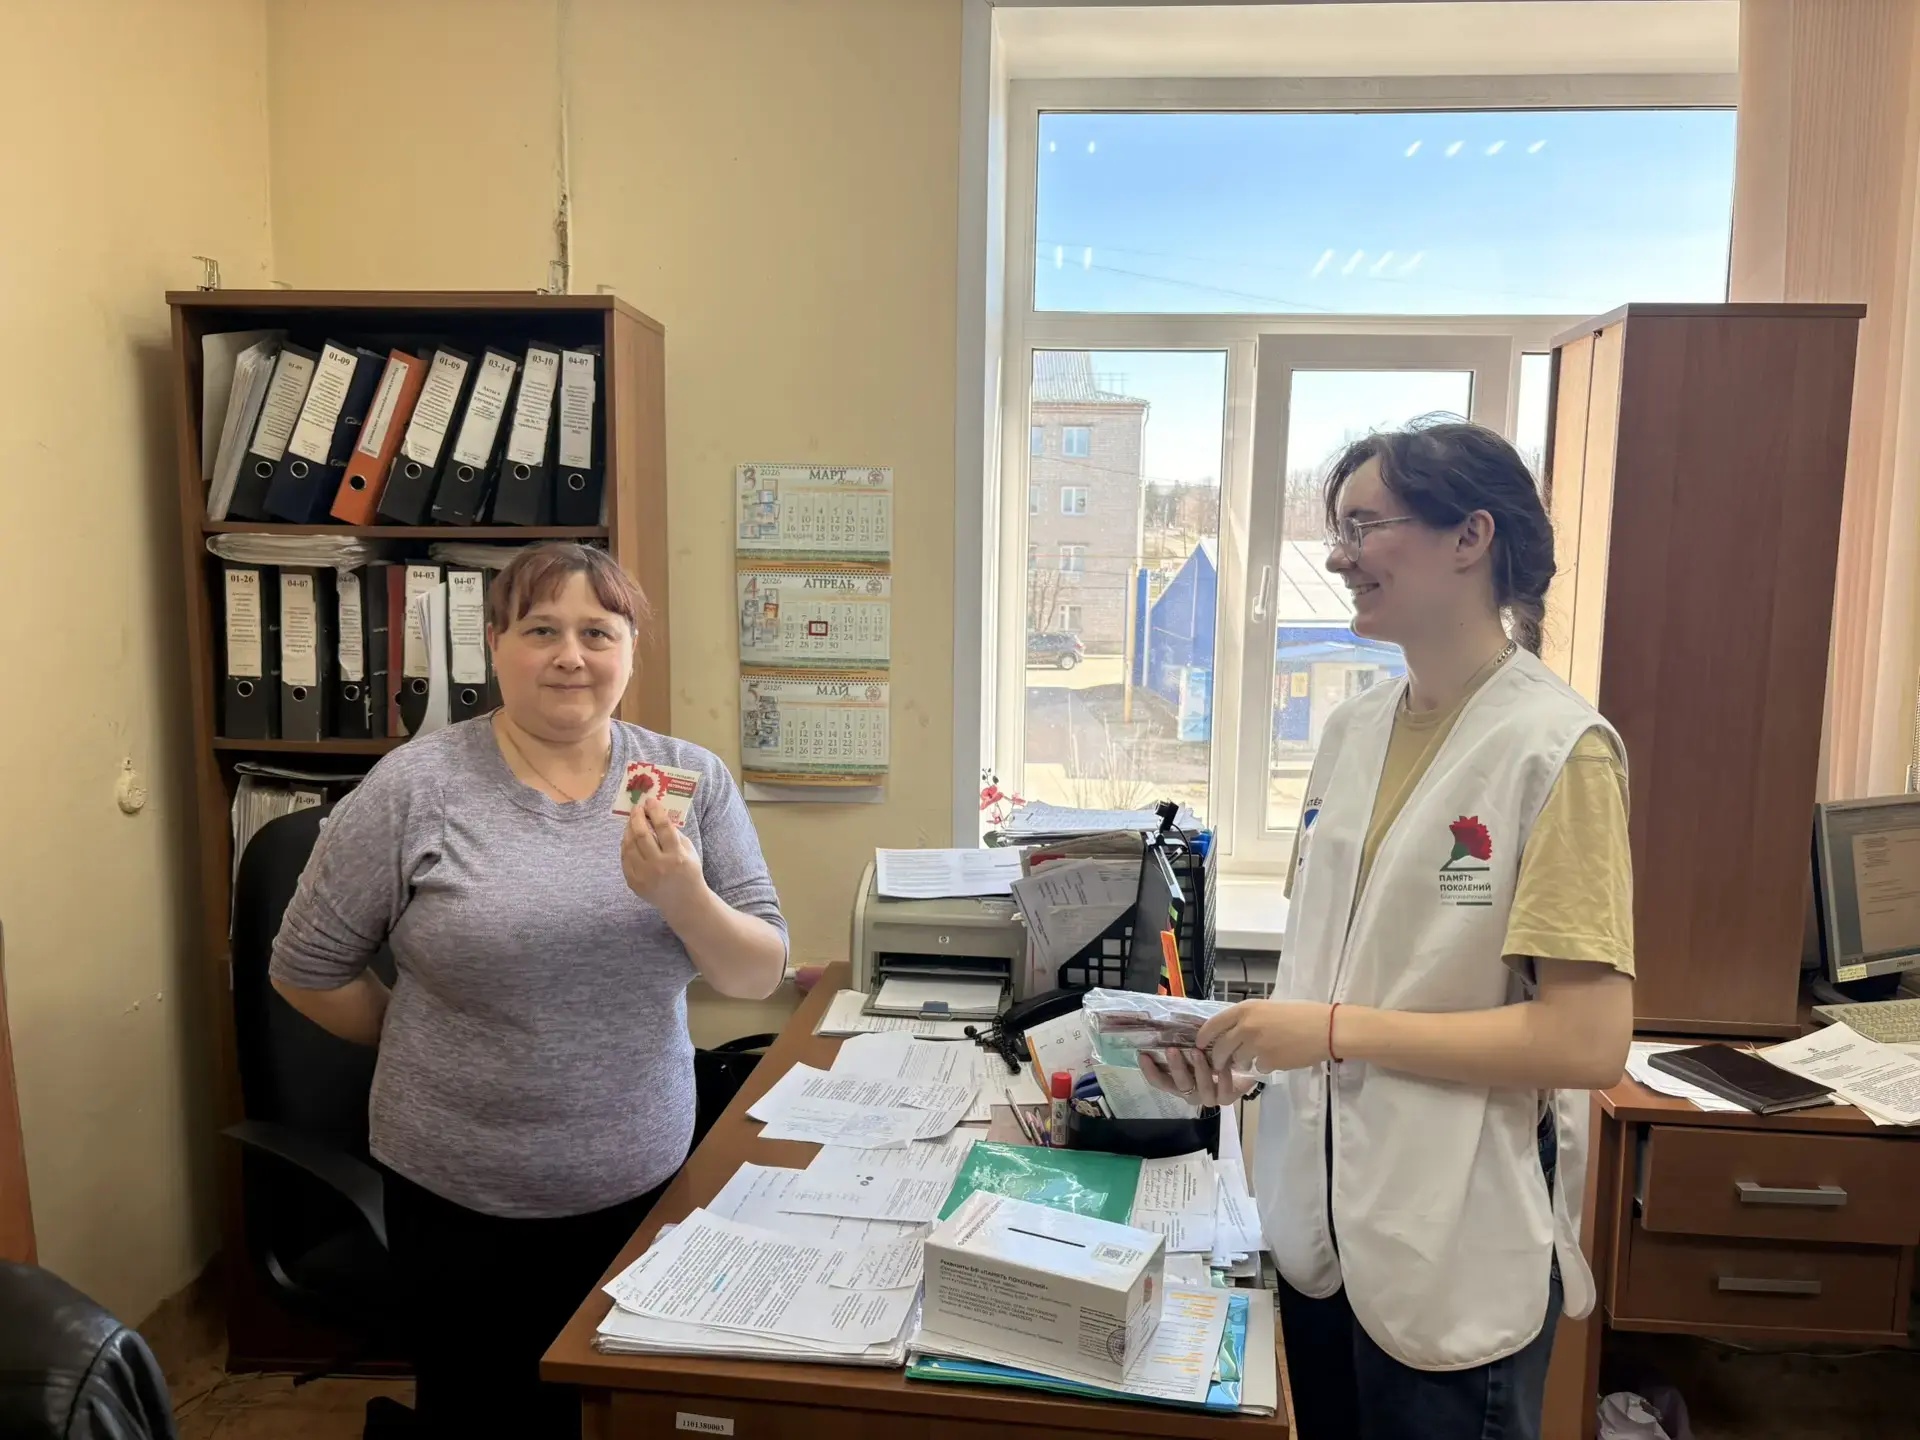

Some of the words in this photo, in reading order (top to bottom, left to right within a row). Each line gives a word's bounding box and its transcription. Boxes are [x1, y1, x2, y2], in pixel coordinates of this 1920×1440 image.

[328, 352, 351, 366] 01-09
[439, 356, 461, 371] 01-09
[532, 354, 554, 366] 03-10
[568, 356, 589, 366] 04-07
[488, 358, 511, 373] 03-14
[809, 470, 846, 480] МАРТ
[230, 575, 254, 584] 01-26
[413, 571, 435, 580] 04-03
[804, 579, 855, 589] АПРЕЛЬ
[816, 684, 849, 696] МАЙ
[1440, 882, 1492, 892] ПОКОЛЕНИЙ
[1073, 1030, 1081, 1040] 15
